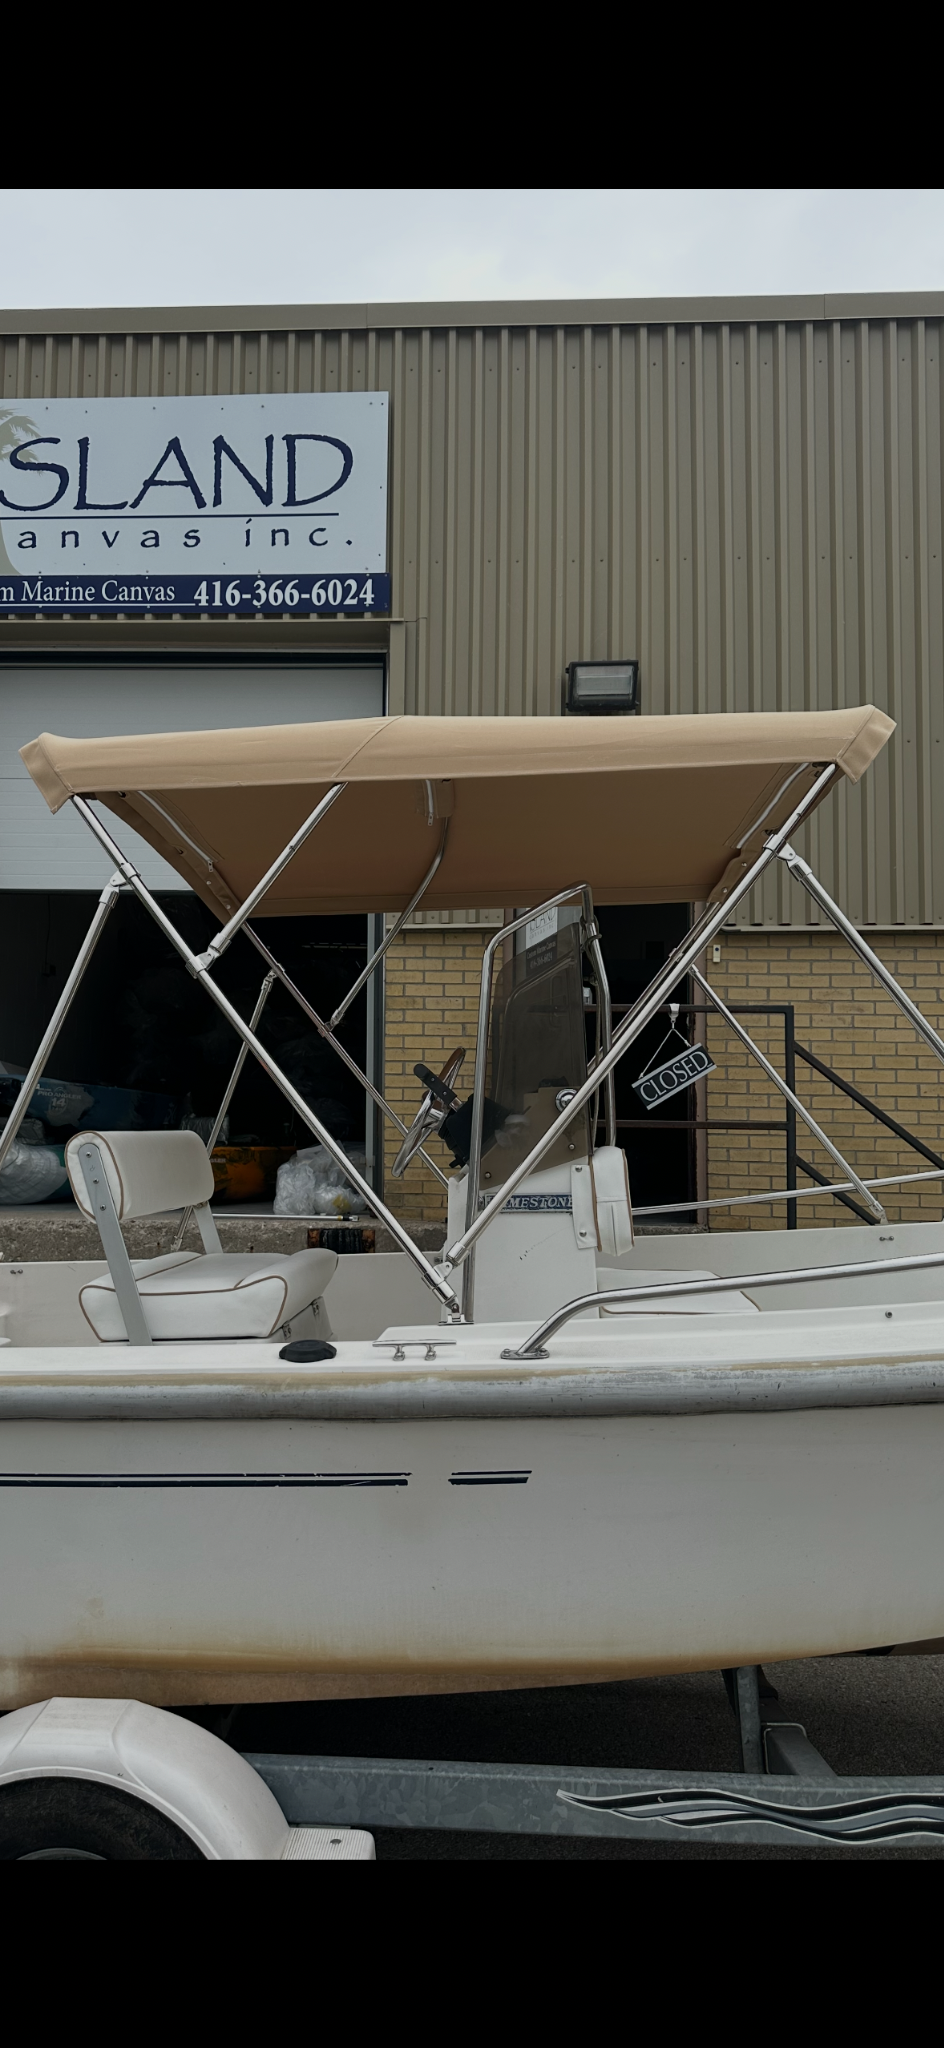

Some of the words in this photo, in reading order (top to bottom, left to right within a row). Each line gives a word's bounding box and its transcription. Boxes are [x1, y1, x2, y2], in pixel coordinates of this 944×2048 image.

[0, 434, 354, 512] SLAND
[17, 528, 202, 549] anvas
[244, 518, 354, 547] inc.
[21, 580, 96, 602] Marine
[101, 579, 176, 602] Canvas
[193, 578, 375, 607] 416-366-6024
[640, 1051, 709, 1102] CLOSED
[51, 1097, 66, 1107] 14
[53, 1092, 82, 1100] ANGLER
[484, 1195, 573, 1209] MESTON
